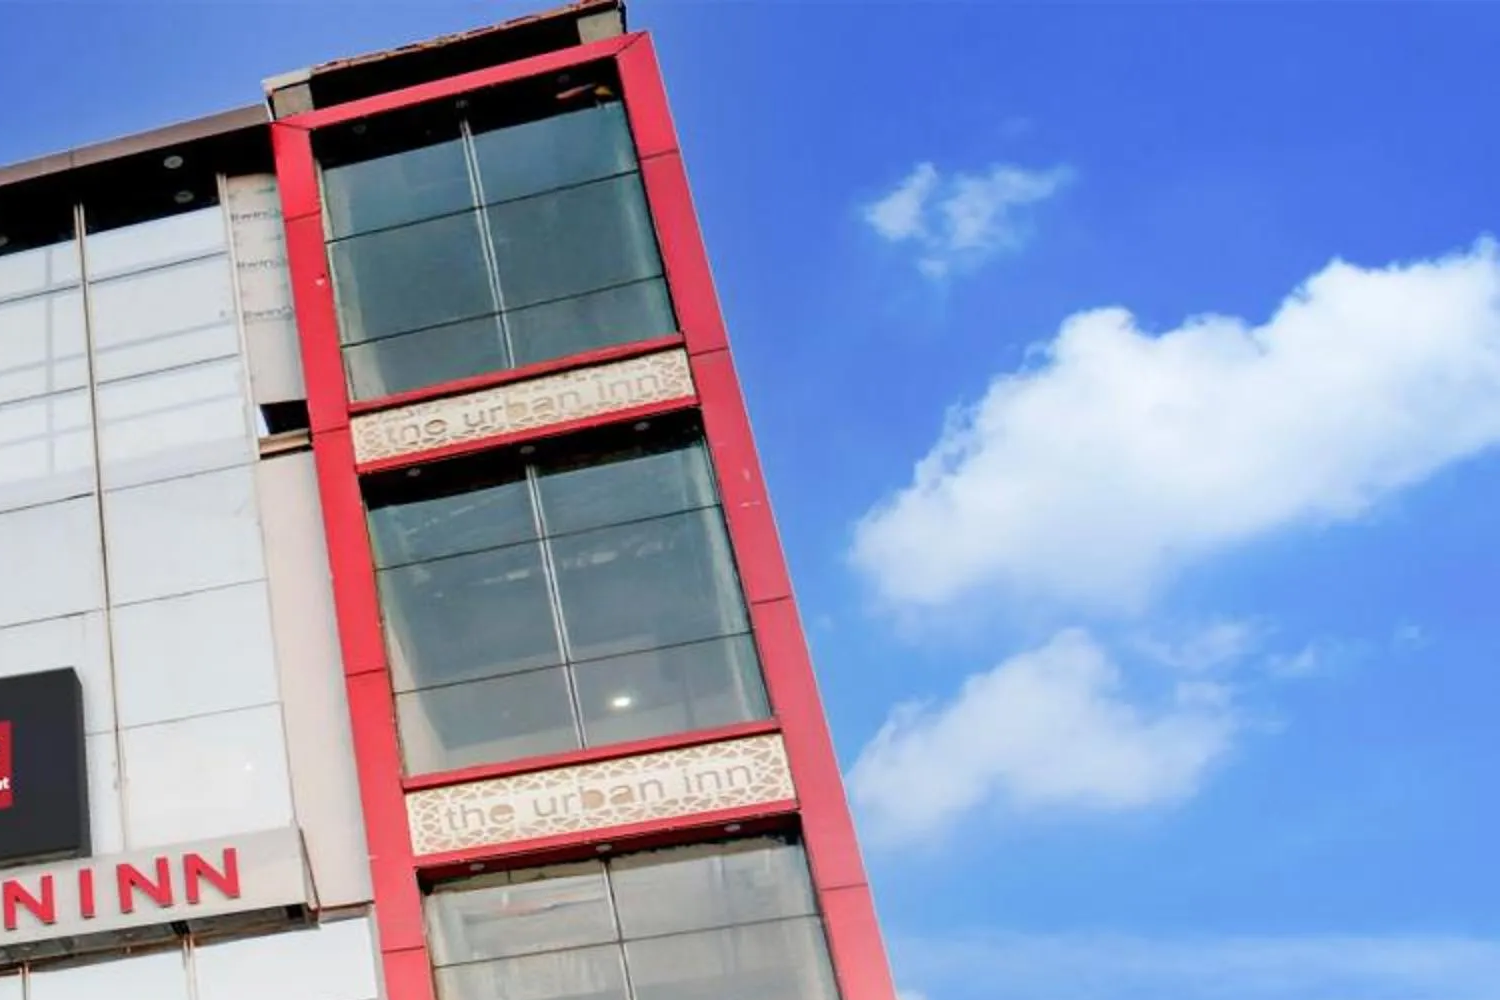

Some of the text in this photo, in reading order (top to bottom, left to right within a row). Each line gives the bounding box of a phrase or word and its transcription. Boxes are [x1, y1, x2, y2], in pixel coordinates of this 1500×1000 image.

[462, 387, 581, 428] urban
[596, 371, 660, 403] inn
[444, 760, 754, 833] the urban inn
[78, 848, 241, 919] INN
